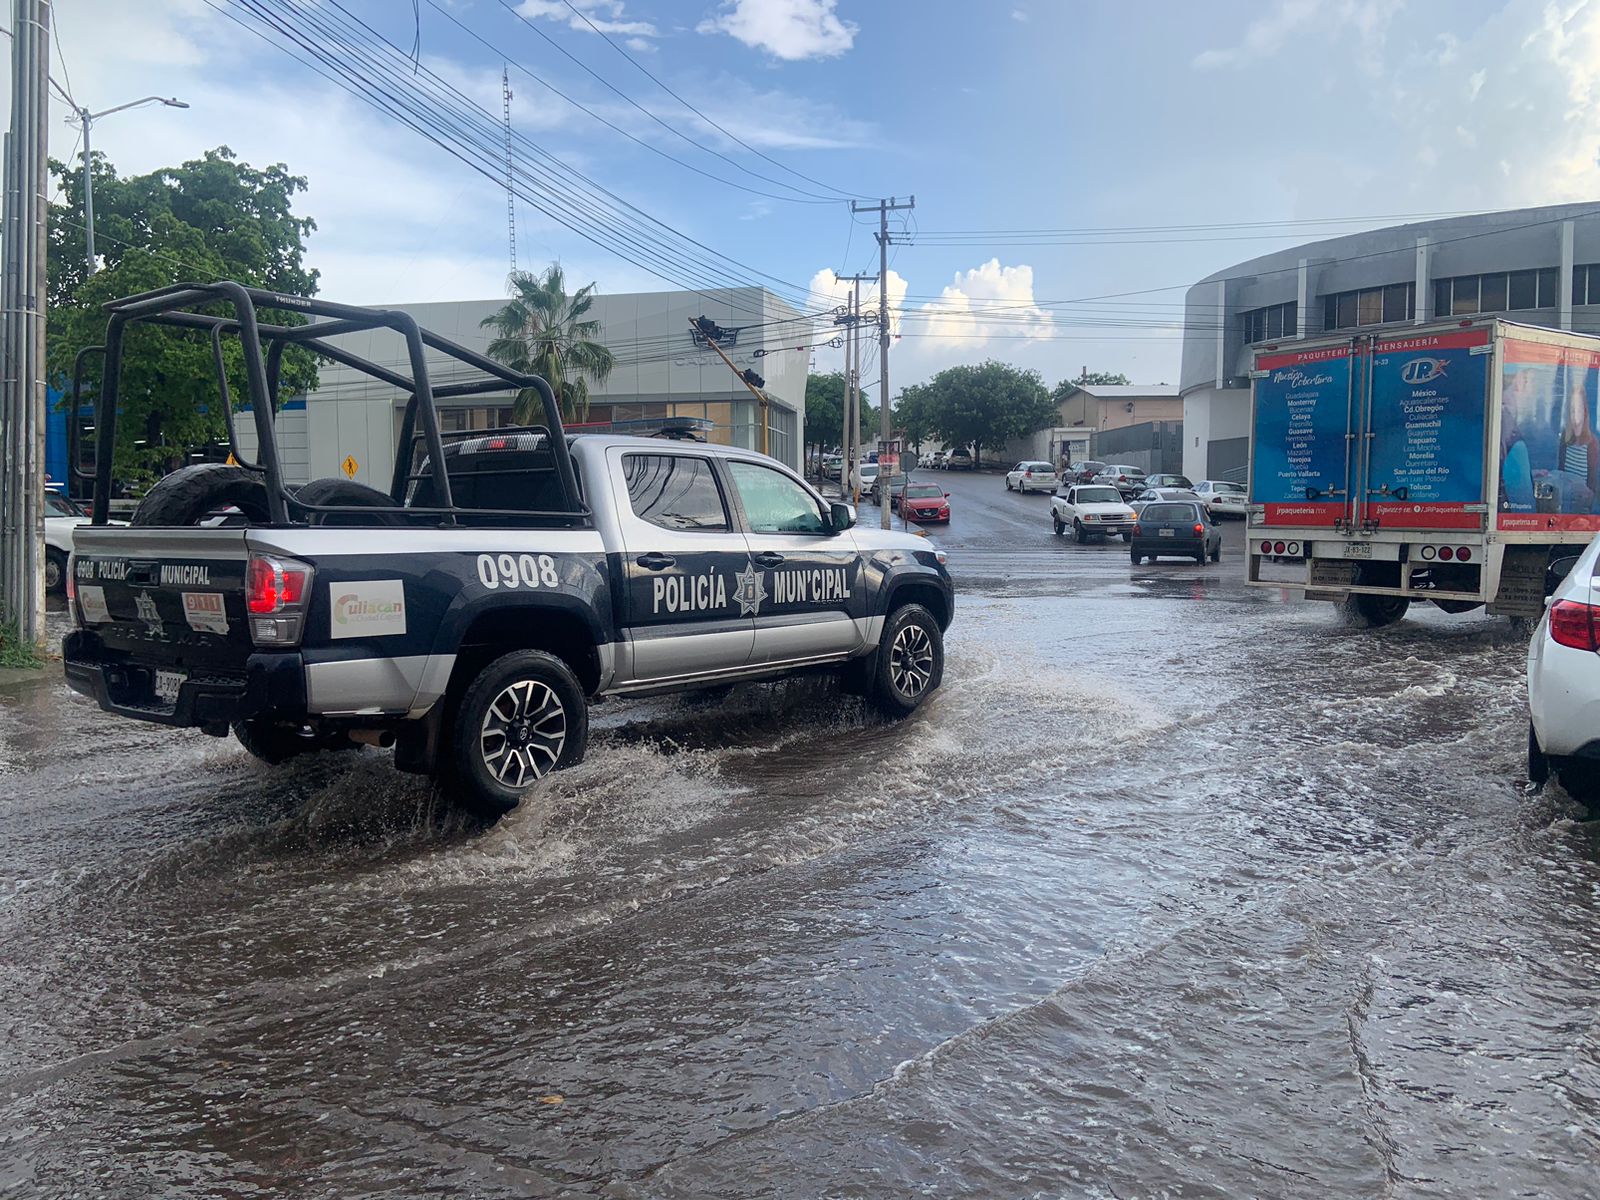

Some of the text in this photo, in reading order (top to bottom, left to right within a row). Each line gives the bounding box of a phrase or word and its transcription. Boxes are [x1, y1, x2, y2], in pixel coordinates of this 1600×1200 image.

[275, 295, 312, 307] THUNDER
[1297, 347, 1348, 361] PAQUETERÍ
[674, 356, 758, 367] CADILAC
[1291, 374, 1334, 389] Cobertura
[1412, 389, 1437, 398] México
[1287, 399, 1317, 407] Monterrey
[1291, 413, 1311, 421] Celaya
[1407, 429, 1439, 437] Guaymas
[1408, 437, 1437, 445] Irapuato
[1409, 451, 1435, 459] Morelia
[1408, 467, 1424, 475] Juan
[1425, 467, 1437, 475] del
[1291, 485, 1306, 493] Tepic
[77, 558, 211, 585] 0908 POLICÍA MUNICIPAL
[477, 554, 559, 589] 0908
[653, 565, 727, 614] POLICÍA
[188, 595, 218, 610] 911
